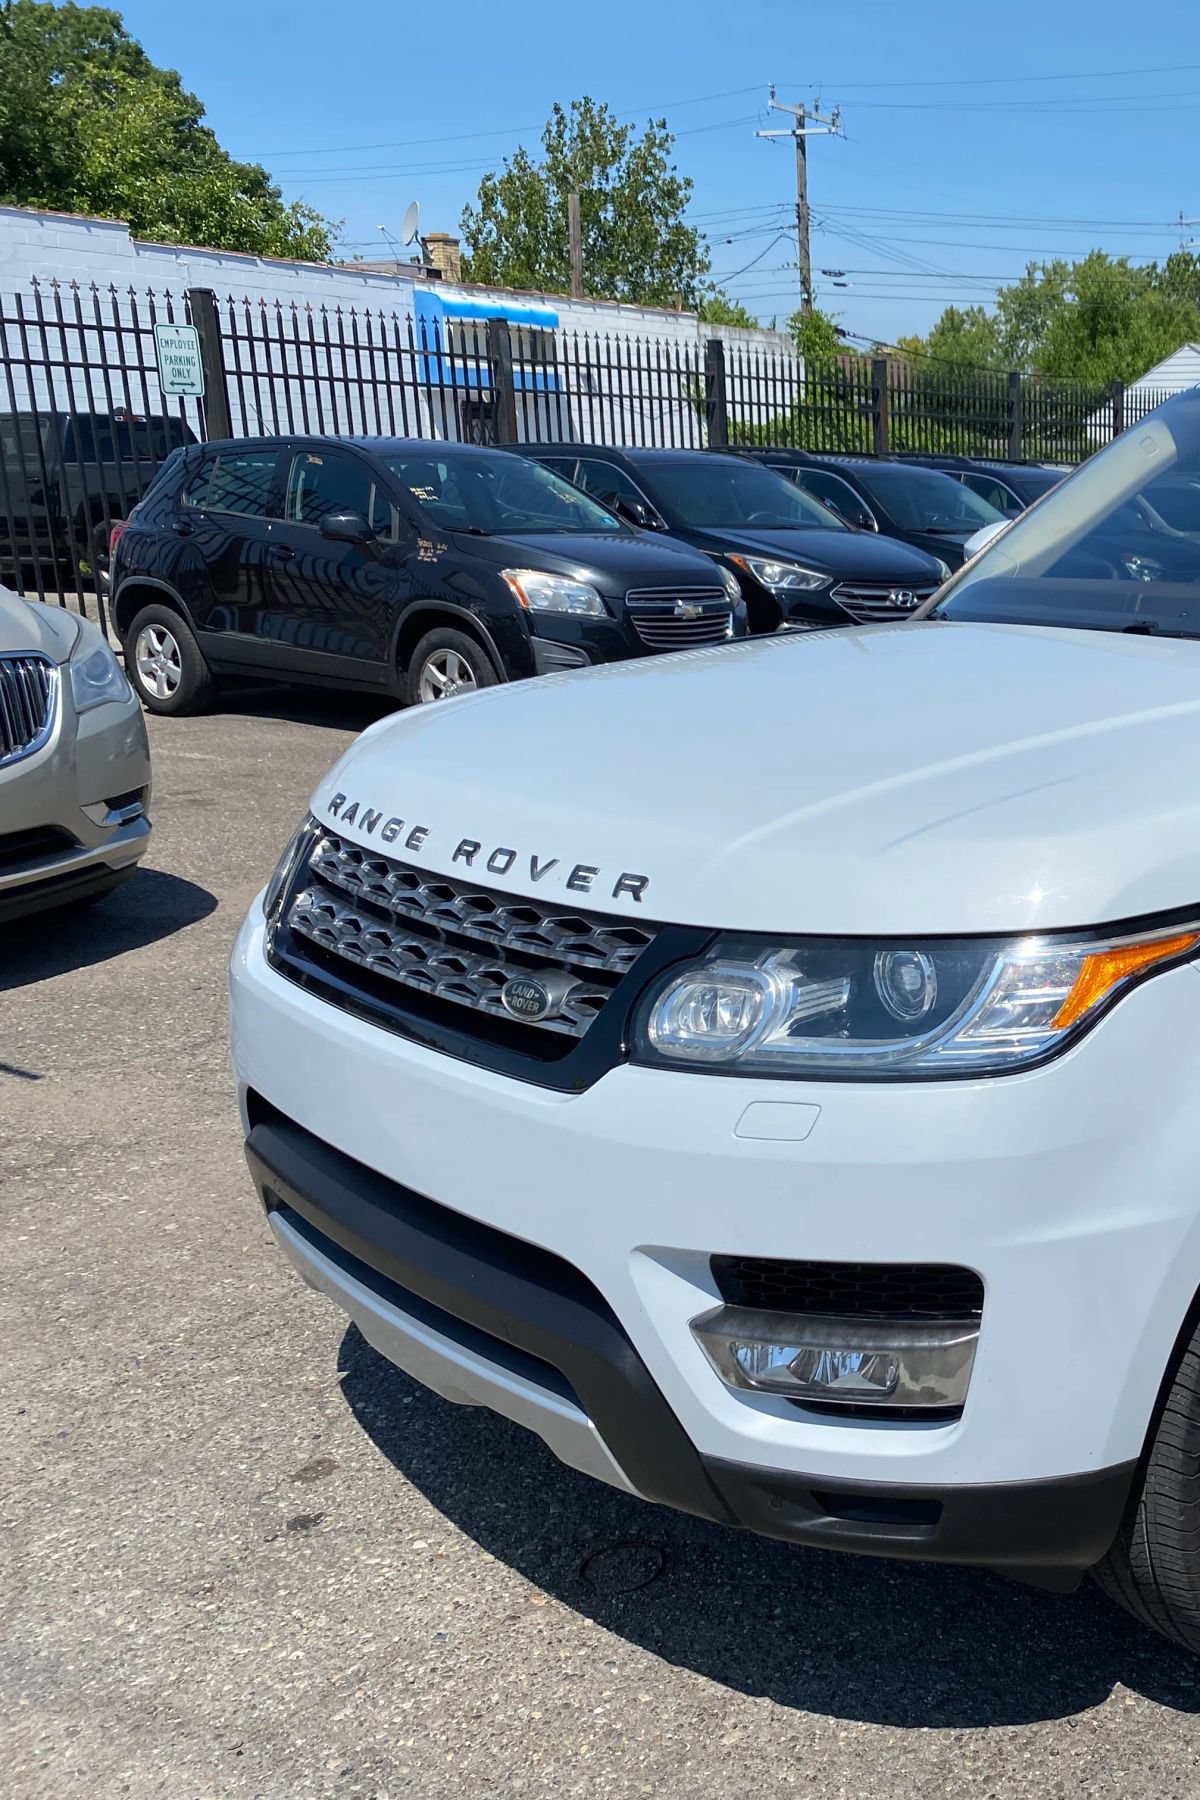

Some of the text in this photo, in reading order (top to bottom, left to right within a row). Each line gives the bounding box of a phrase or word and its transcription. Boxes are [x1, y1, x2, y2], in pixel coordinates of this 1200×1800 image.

[159, 338, 196, 350] EMPLOYEE
[164, 354, 196, 367] PARKING
[171, 367, 191, 379] ONLY
[327, 791, 650, 903] RANGE ROVER
